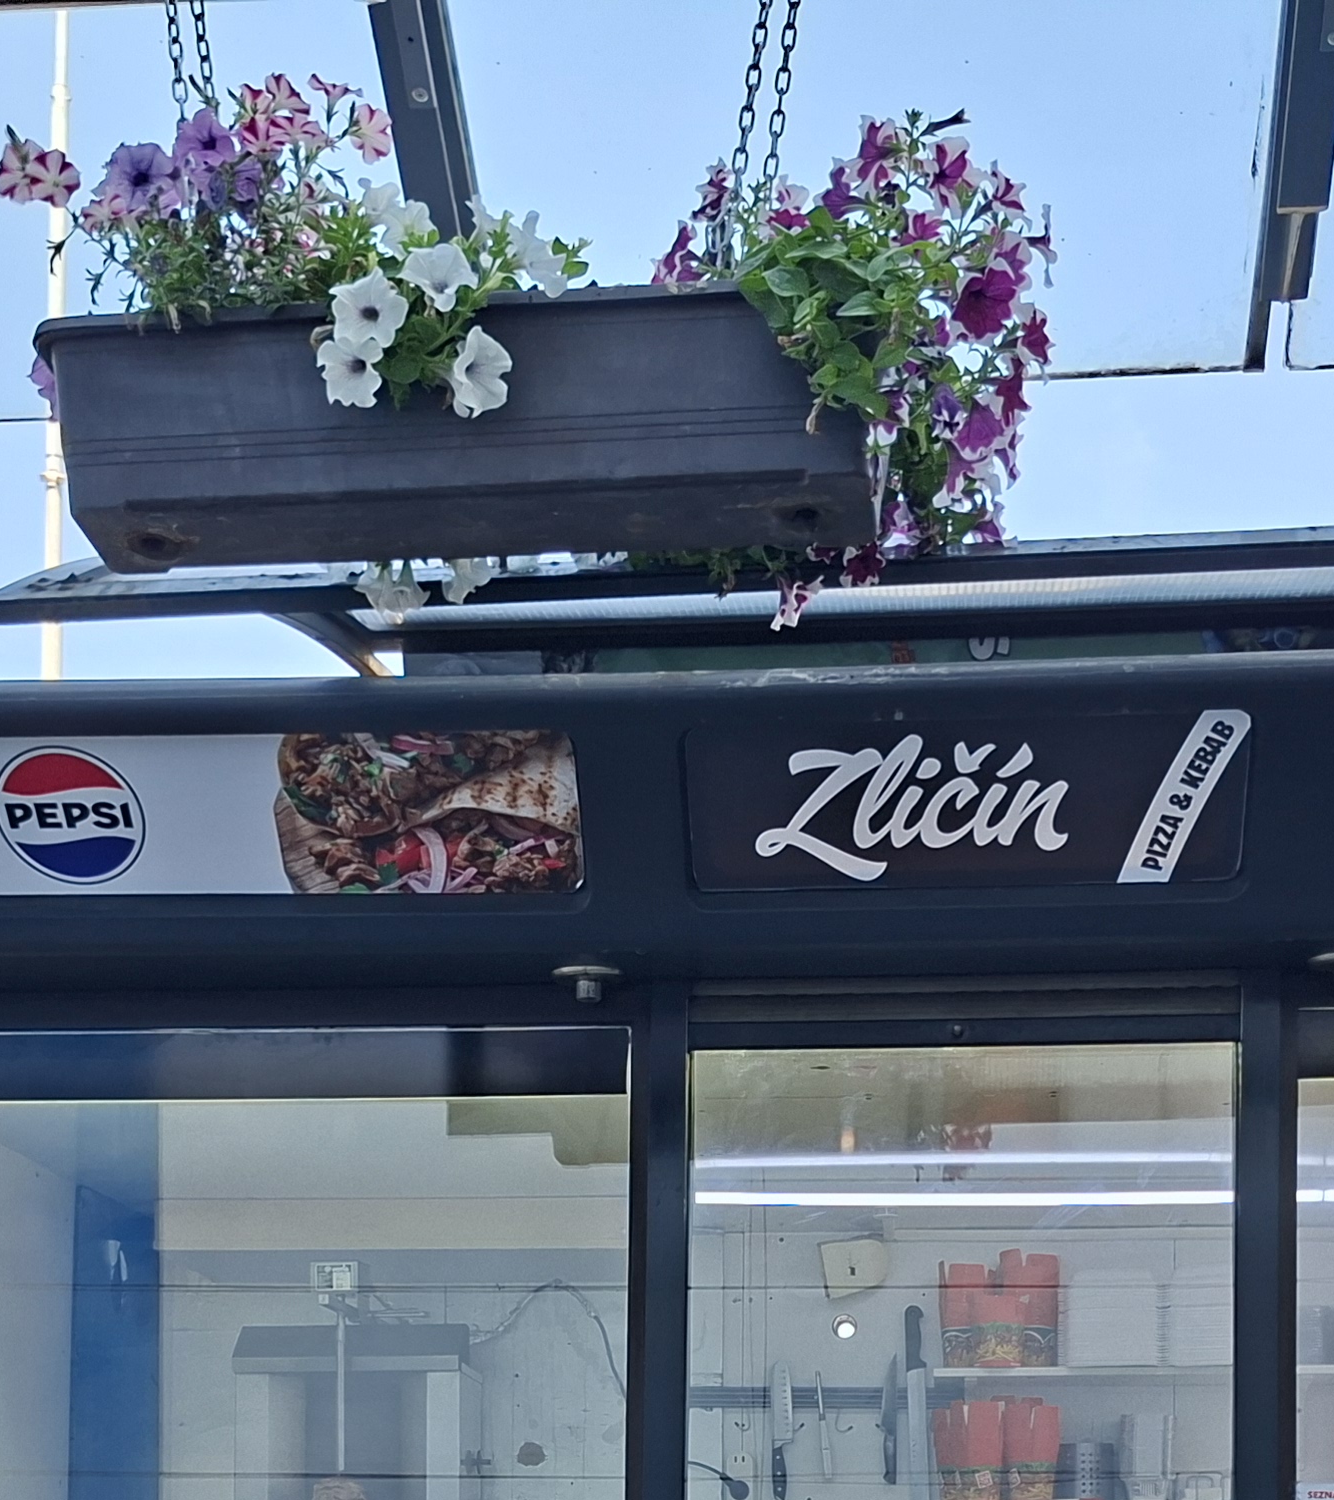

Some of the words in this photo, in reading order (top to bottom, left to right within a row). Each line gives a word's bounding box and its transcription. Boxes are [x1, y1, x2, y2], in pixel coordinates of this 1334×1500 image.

[1179, 720, 1235, 790] KEBAB
[5, 798, 134, 837] PEPSI
[756, 734, 1068, 881] Zličín
[1169, 793, 1192, 813] &
[1141, 810, 1180, 873] PIZZA
